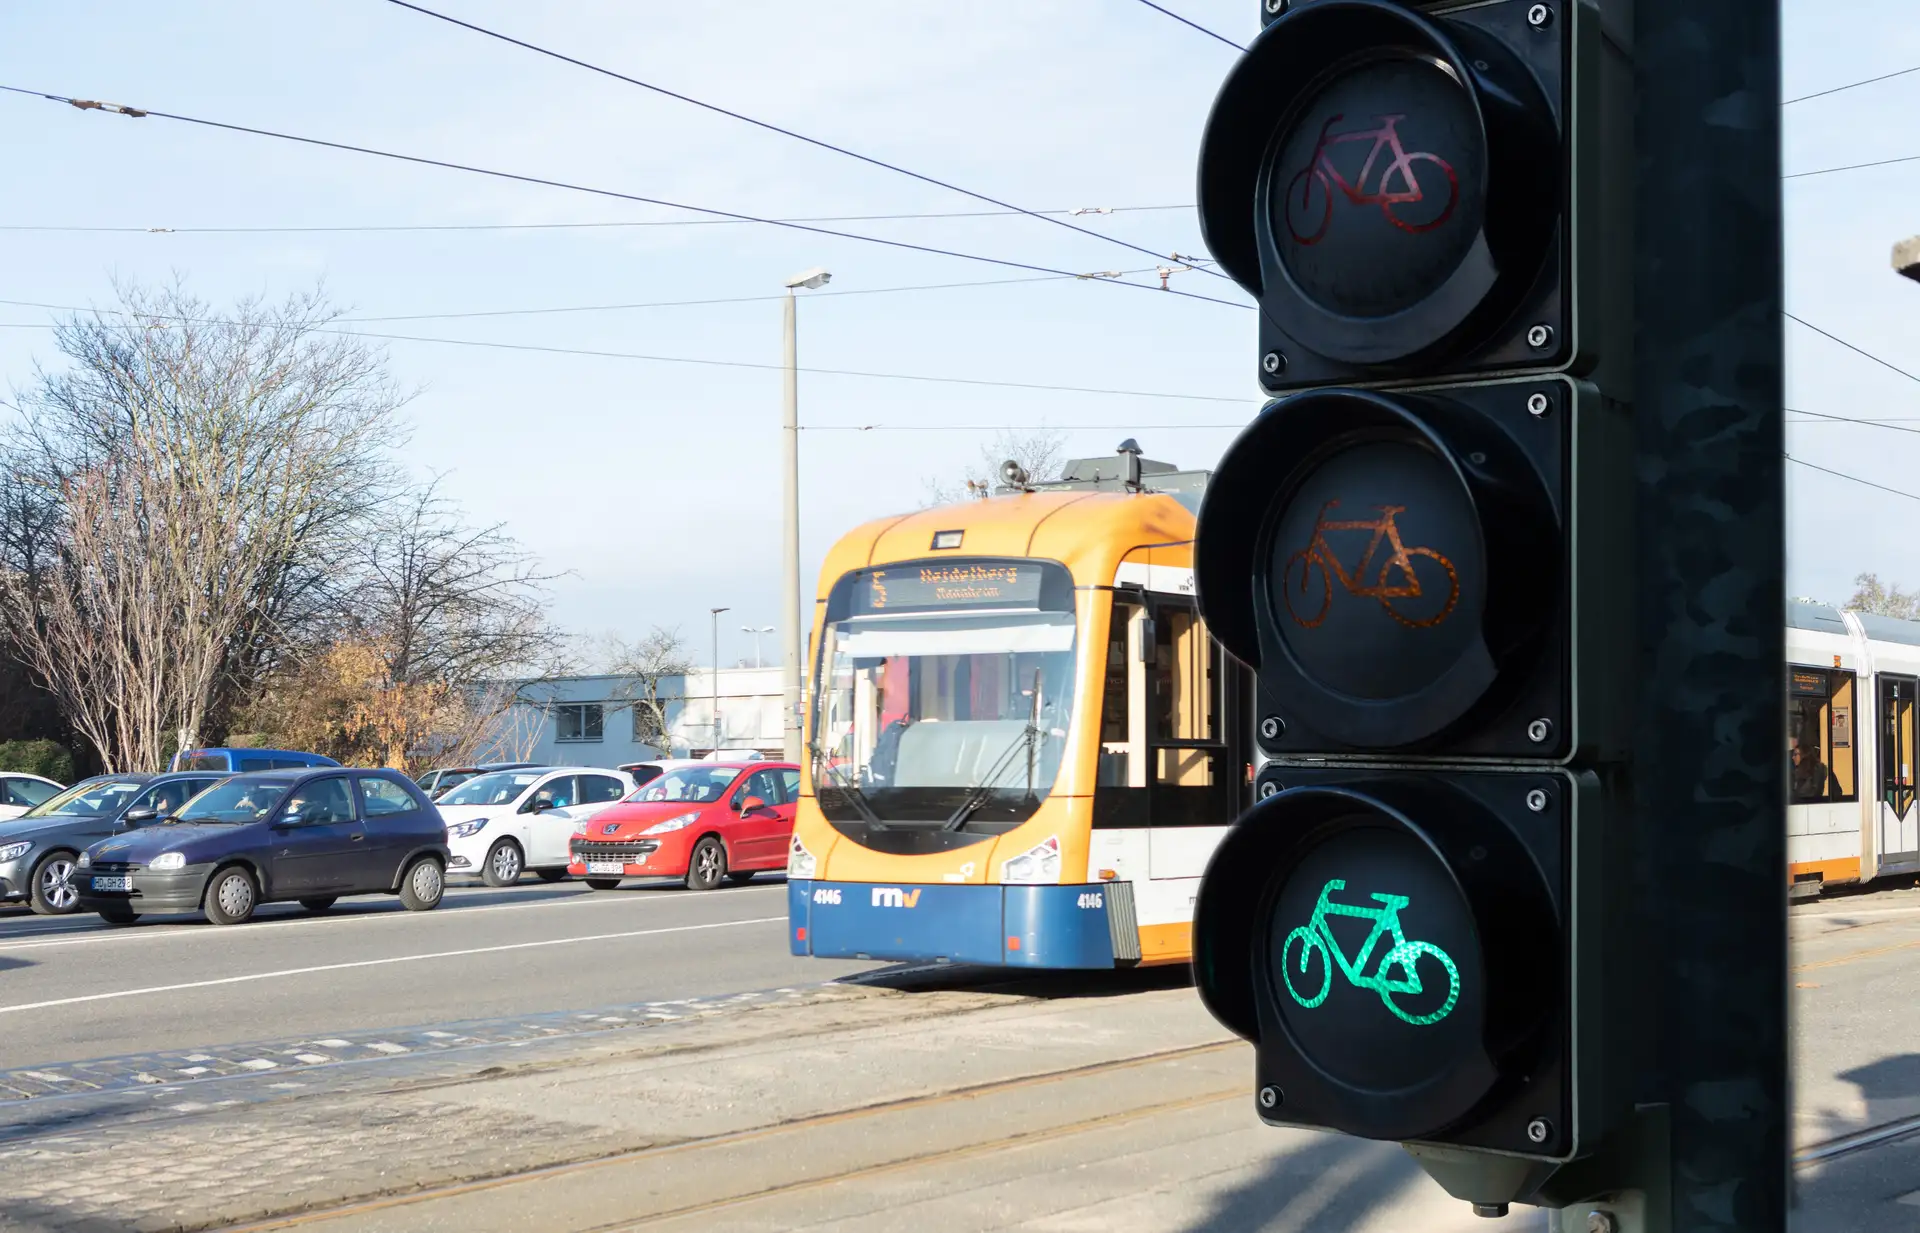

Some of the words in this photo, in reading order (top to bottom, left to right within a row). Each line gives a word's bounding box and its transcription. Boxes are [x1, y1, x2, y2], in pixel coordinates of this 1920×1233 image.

[920, 566, 1018, 584] Heidelberg
[872, 571, 887, 608] 5
[813, 889, 842, 905] 4146
[1077, 893, 1103, 909] 4146
